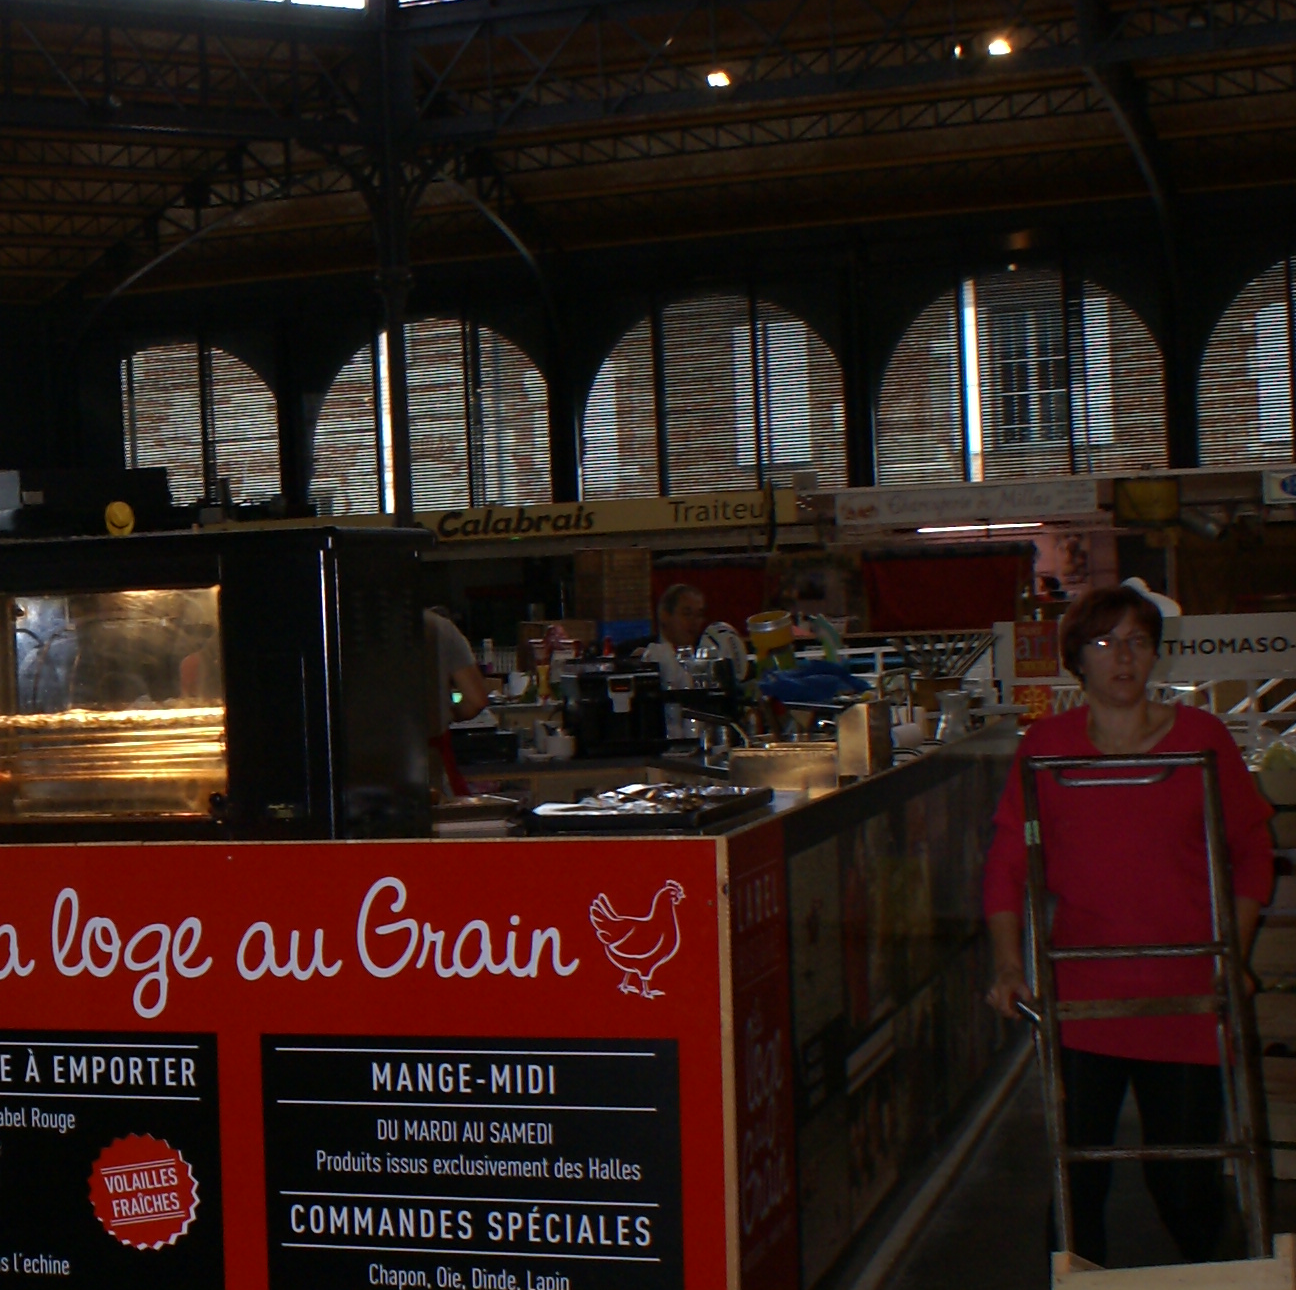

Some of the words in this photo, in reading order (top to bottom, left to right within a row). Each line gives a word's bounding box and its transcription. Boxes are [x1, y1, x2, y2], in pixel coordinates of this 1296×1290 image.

[438, 506, 594, 537] Calabrais
[51, 887, 214, 1019] loge
[236, 921, 343, 982] au
[356, 876, 580, 979] Grain
[24, 1048, 41, 1083] À
[53, 1055, 196, 1087] EMPORTER
[371, 1061, 555, 1095] MANGE-MIDI
[31, 1108, 76, 1134] Rouge
[377, 1118, 399, 1141] DU
[404, 1119, 458, 1142] MARDI
[462, 1121, 485, 1144] AU
[489, 1121, 553, 1145] SAMEDI
[104, 1168, 178, 1193] VOLAILLES
[316, 1149, 382, 1173] Produits
[386, 1152, 428, 1175] issus
[433, 1154, 550, 1178] exclusivement
[554, 1156, 584, 1179] des
[588, 1157, 642, 1181] Halles
[112, 1193, 180, 1217] FRAÎCHES
[290, 1204, 473, 1240] COMMANDES
[487, 1205, 651, 1247] SPÉCIALES
[368, 1263, 432, 1290] Chapon,
[436, 1266, 466, 1290] Oie,
